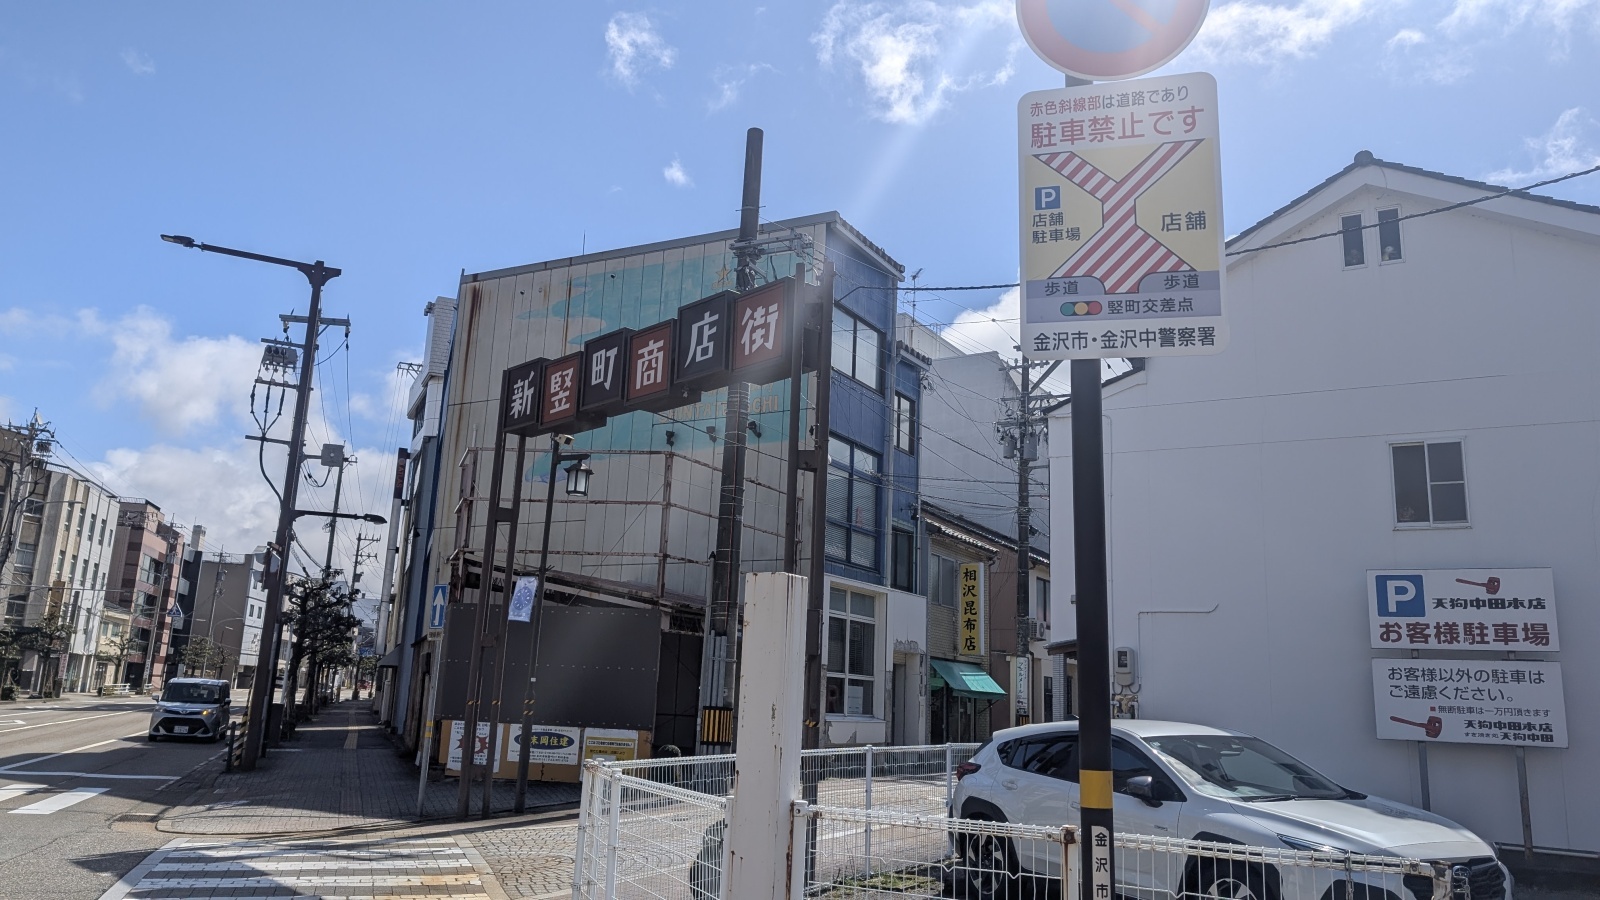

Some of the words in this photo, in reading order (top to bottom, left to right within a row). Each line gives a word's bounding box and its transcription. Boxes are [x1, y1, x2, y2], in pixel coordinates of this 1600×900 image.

[1029, 85, 1190, 117] 赤色斜線部は道路であり
[1030, 106, 1205, 149] 駐車禁止です
[1040, 188, 1056, 208] P
[1032, 211, 1064, 228] 店舗
[1160, 210, 1207, 232] 店舗
[1031, 227, 1081, 245] 駐車場
[1044, 280, 1079, 296] 歩道
[1163, 273, 1200, 290] 歩道
[1107, 297, 1194, 315] 竪町交差点
[1033, 326, 1216, 352] 金沢市・金沢中警察署
[509, 302, 779, 420] 新竪町商店街
[1386, 580, 1416, 613] P
[1431, 597, 1546, 610] 天狗中田本店
[962, 567, 978, 651] 相沢昆布店
[1379, 621, 1551, 647] お客様駐車場
[1388, 666, 1546, 685] お客様以外の駐車は
[1389, 684, 1514, 703] ご遠慮ください。
[1437, 705, 1551, 718] 無断駐車は一万円頂きます
[1463, 719, 1554, 733] 天狗中田本店
[1094, 832, 1108, 899] 金沢市
